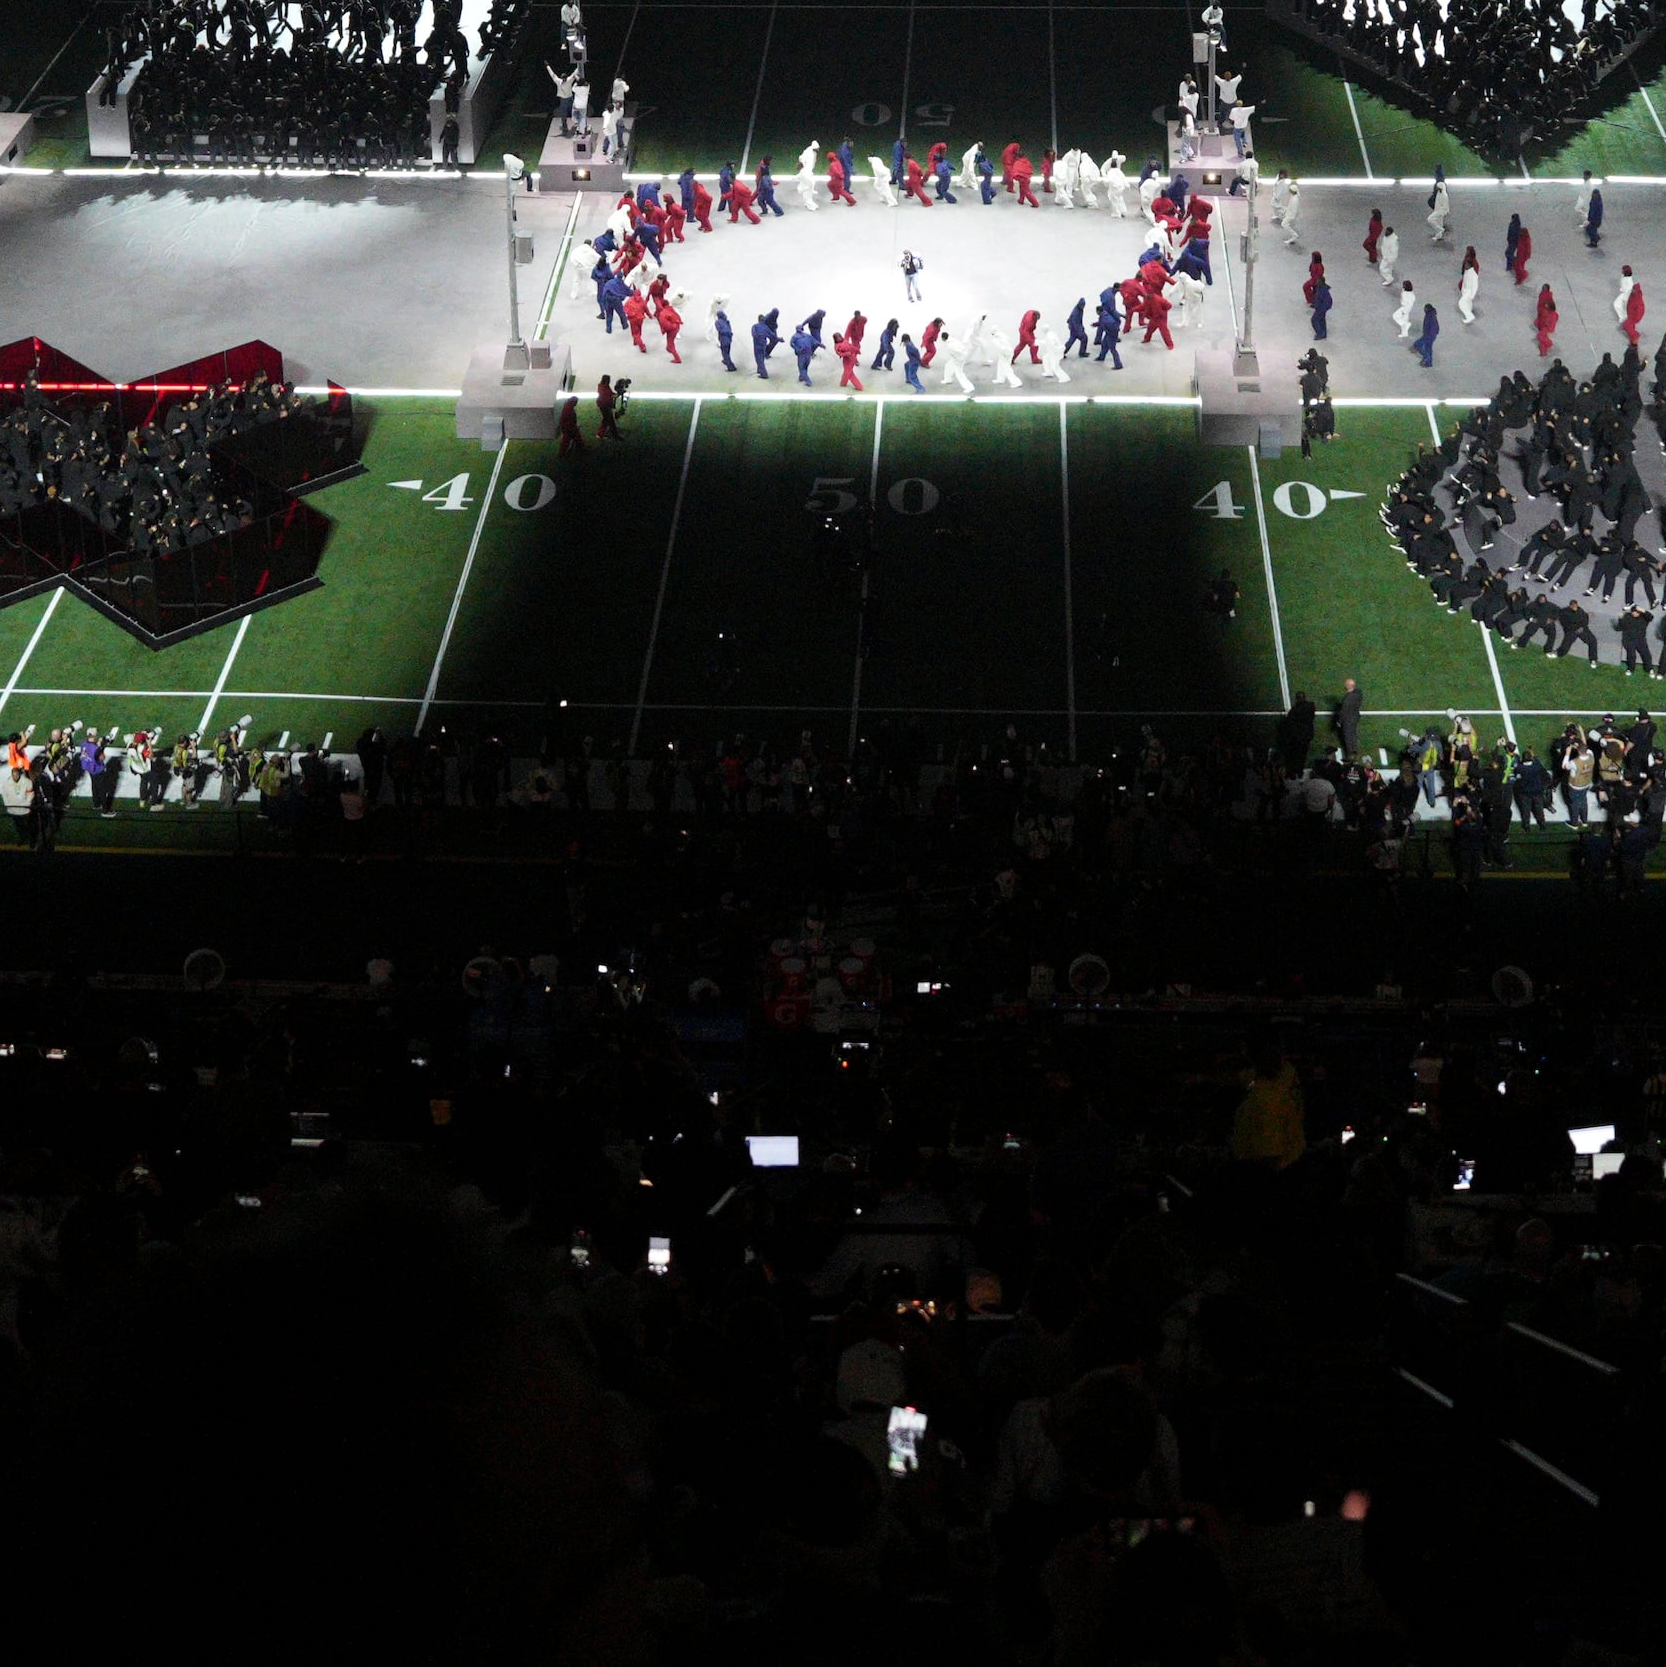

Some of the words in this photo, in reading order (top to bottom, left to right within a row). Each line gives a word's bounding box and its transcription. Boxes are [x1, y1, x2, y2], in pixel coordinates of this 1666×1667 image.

[421, 472, 558, 512] 40
[804, 476, 941, 516] 50
[1192, 480, 1330, 521] 40
